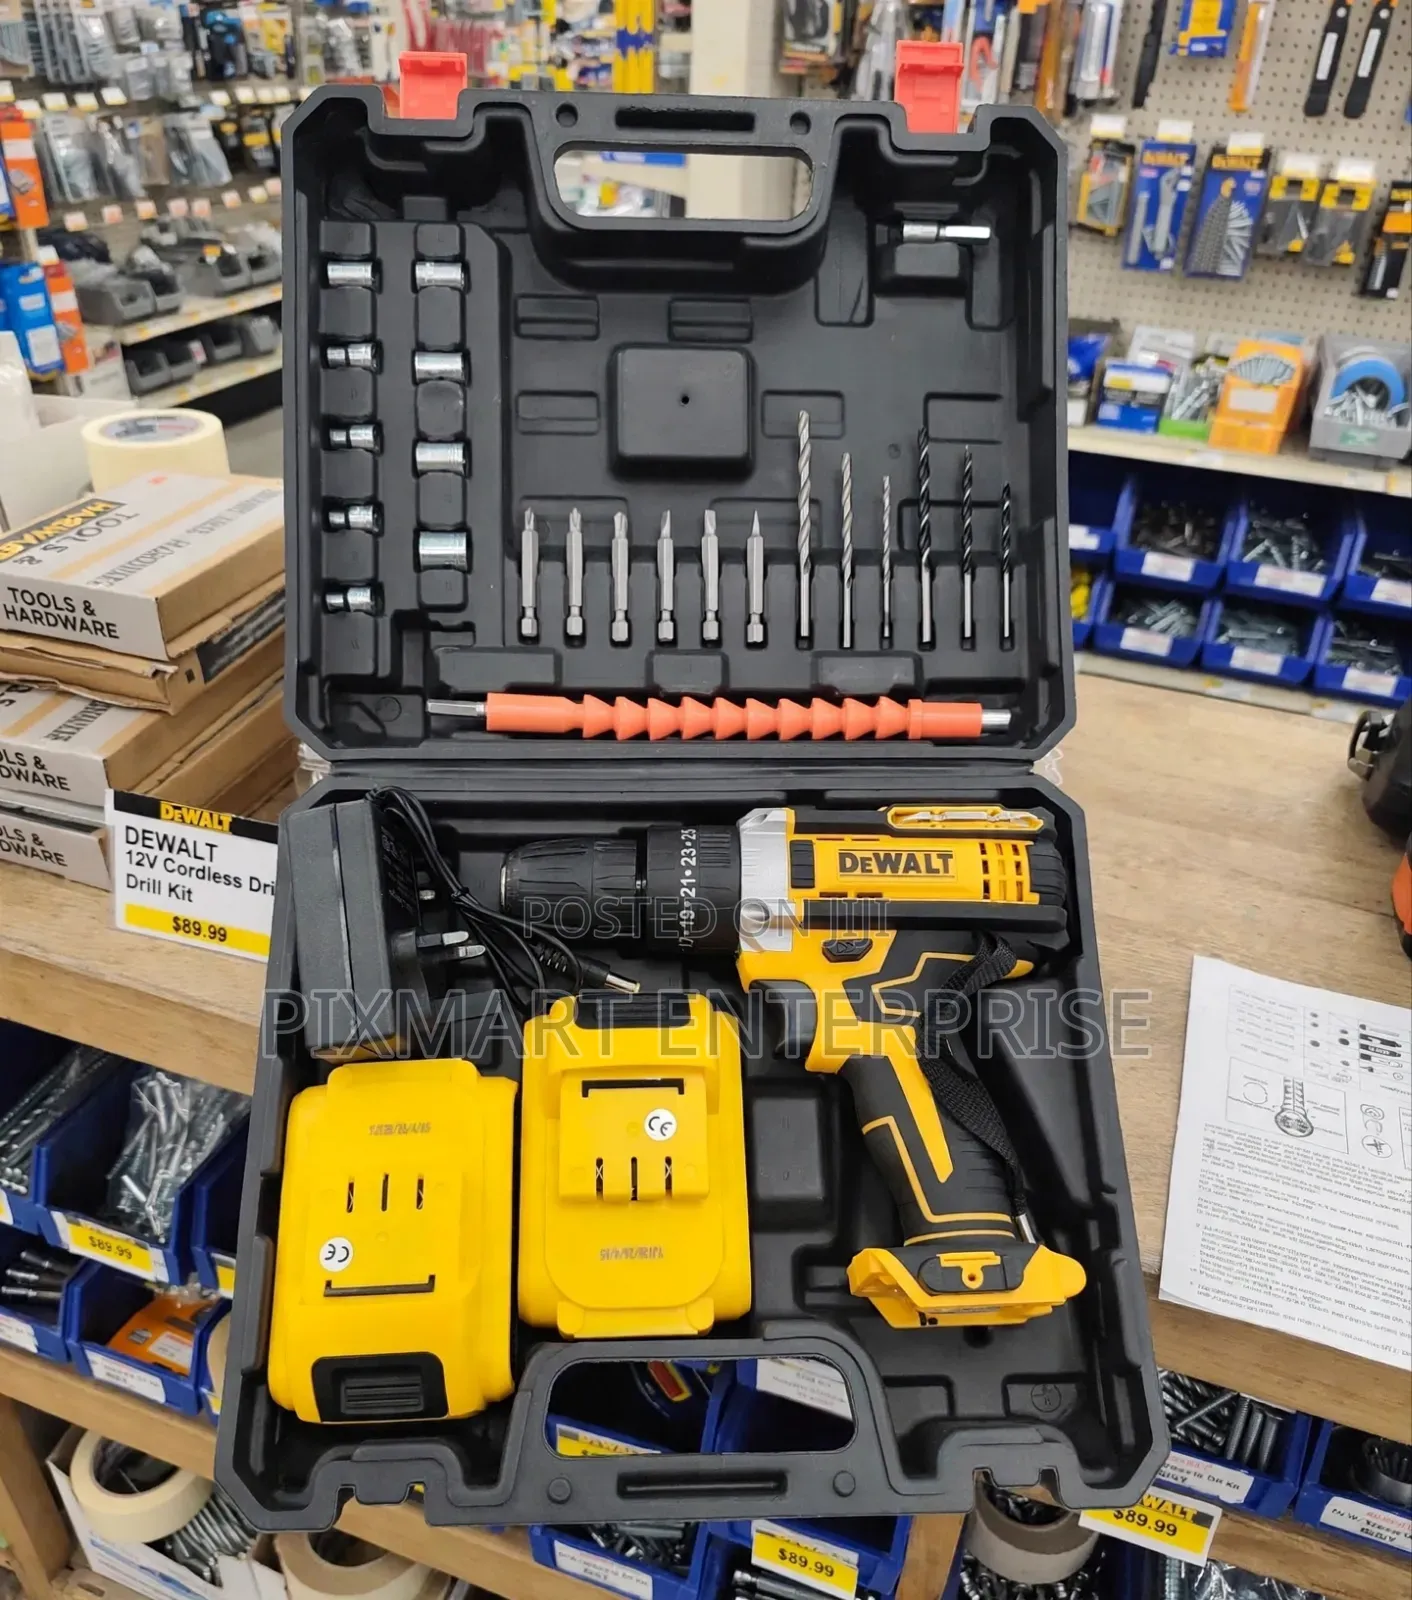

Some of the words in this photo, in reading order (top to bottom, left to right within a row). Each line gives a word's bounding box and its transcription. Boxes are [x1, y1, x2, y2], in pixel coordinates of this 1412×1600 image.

[7, 587, 76, 613] TOOLS
[82, 600, 96, 616] &
[3, 604, 120, 639] HARDWARE
[33, 756, 48, 771] &
[160, 801, 232, 833] DEWALT
[32, 833, 45, 847] &
[125, 825, 218, 862] DEWALT
[126, 850, 157, 869] 12V
[163, 857, 242, 888] Cordless
[680, 848, 696, 866] 23
[838, 852, 953, 874] DEWALT
[126, 873, 161, 895] Drill
[168, 882, 193, 903] Kit
[680, 879, 696, 898] 21
[172, 916, 228, 942] $89.99
[1113, 1508, 1178, 1537] $89.99
[777, 1547, 835, 1578] $89.99
